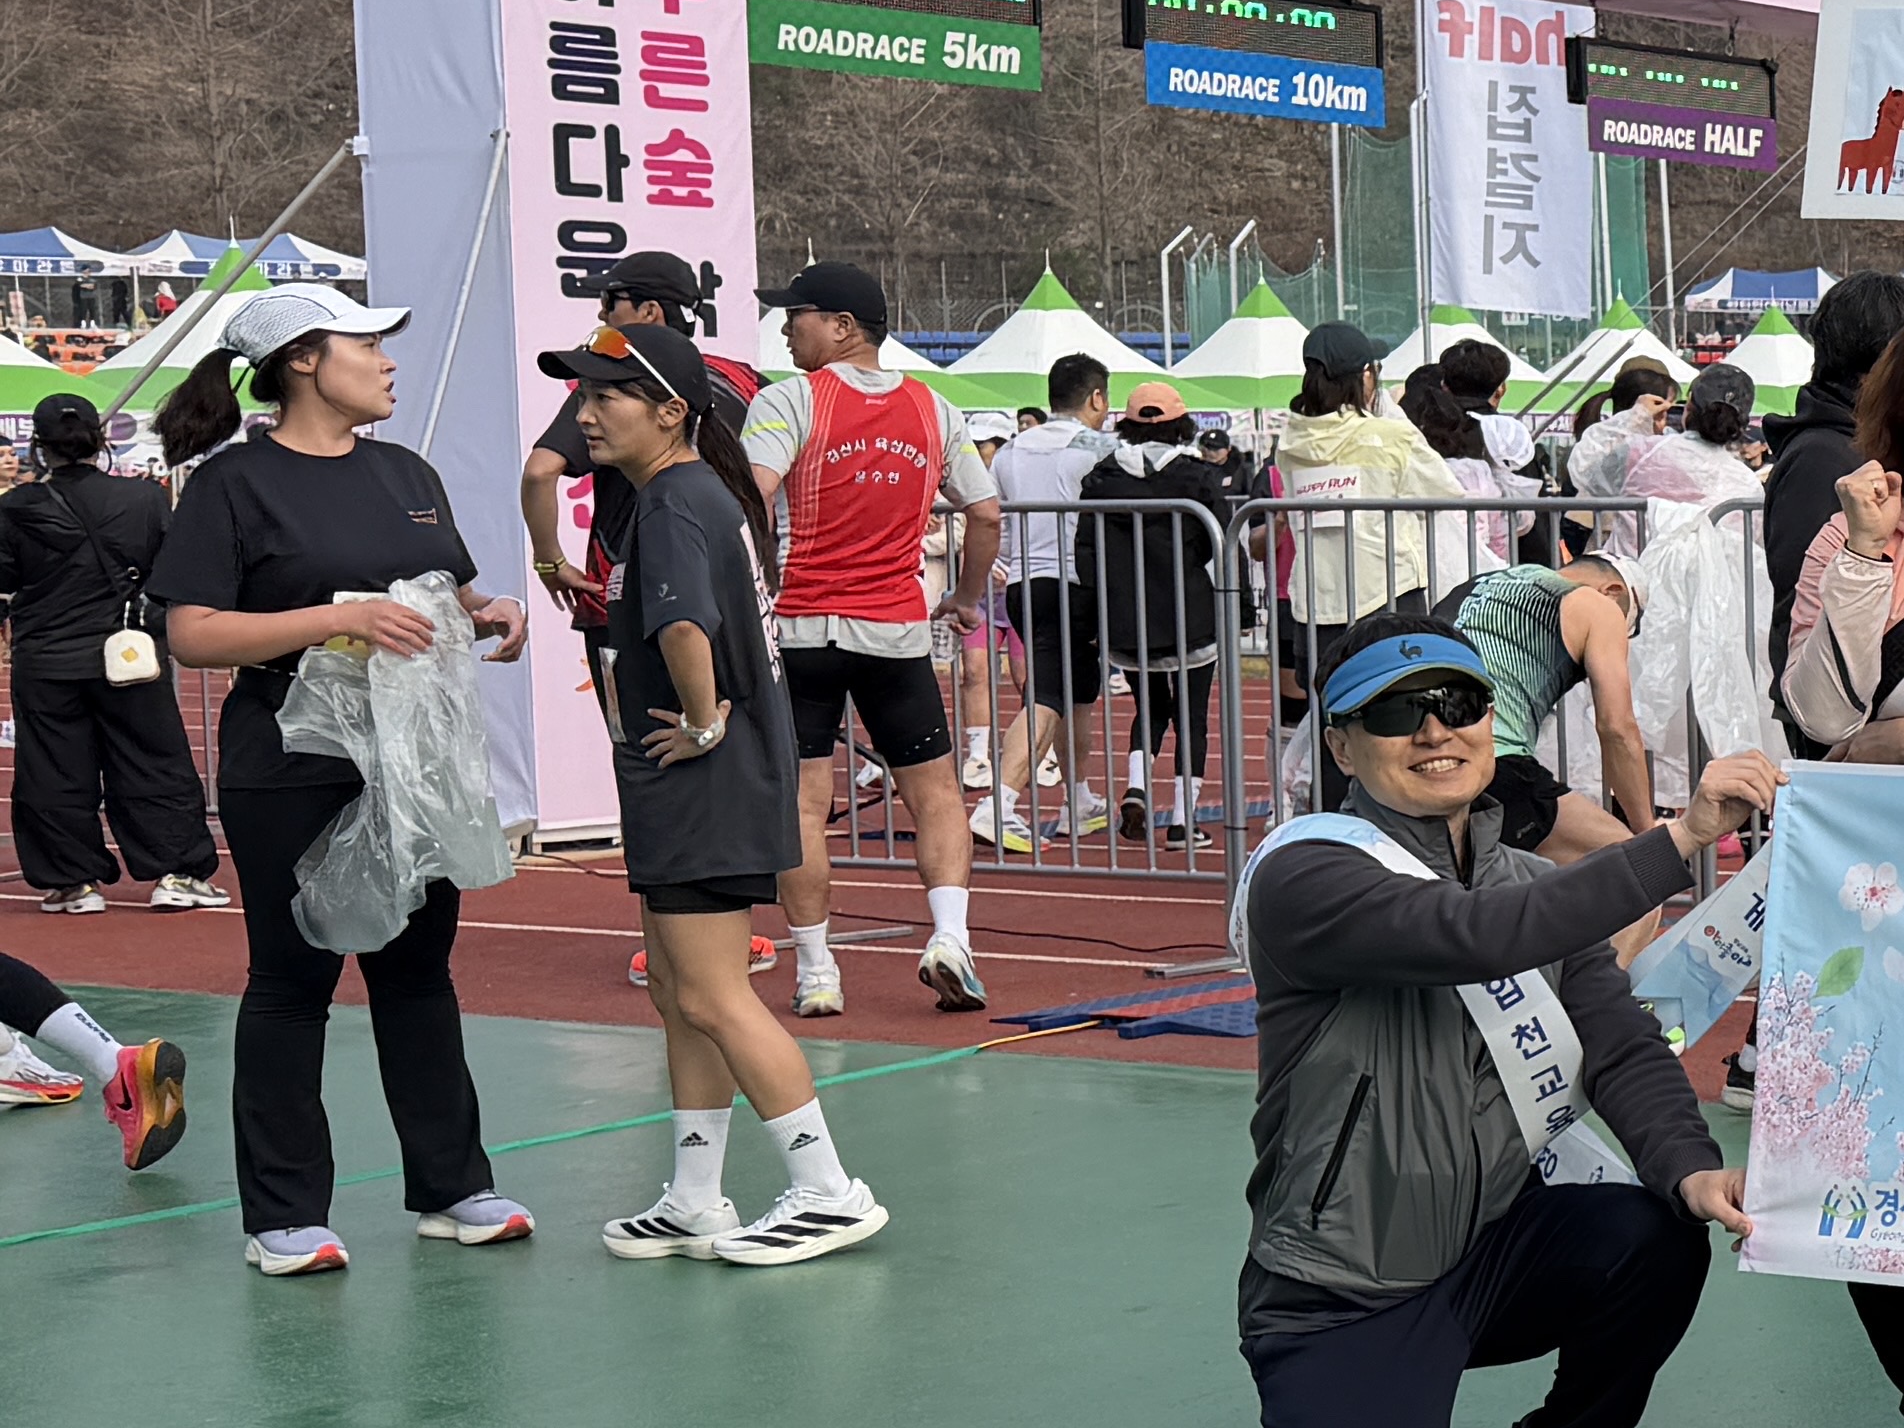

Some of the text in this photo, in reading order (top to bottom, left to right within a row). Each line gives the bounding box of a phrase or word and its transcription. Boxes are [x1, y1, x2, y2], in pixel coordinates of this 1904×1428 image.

[777, 23, 1020, 75] ROADRACE 5km
[1169, 67, 1367, 112] ROADRACE 10km
[1603, 120, 1763, 157] ROADRACE HALF
